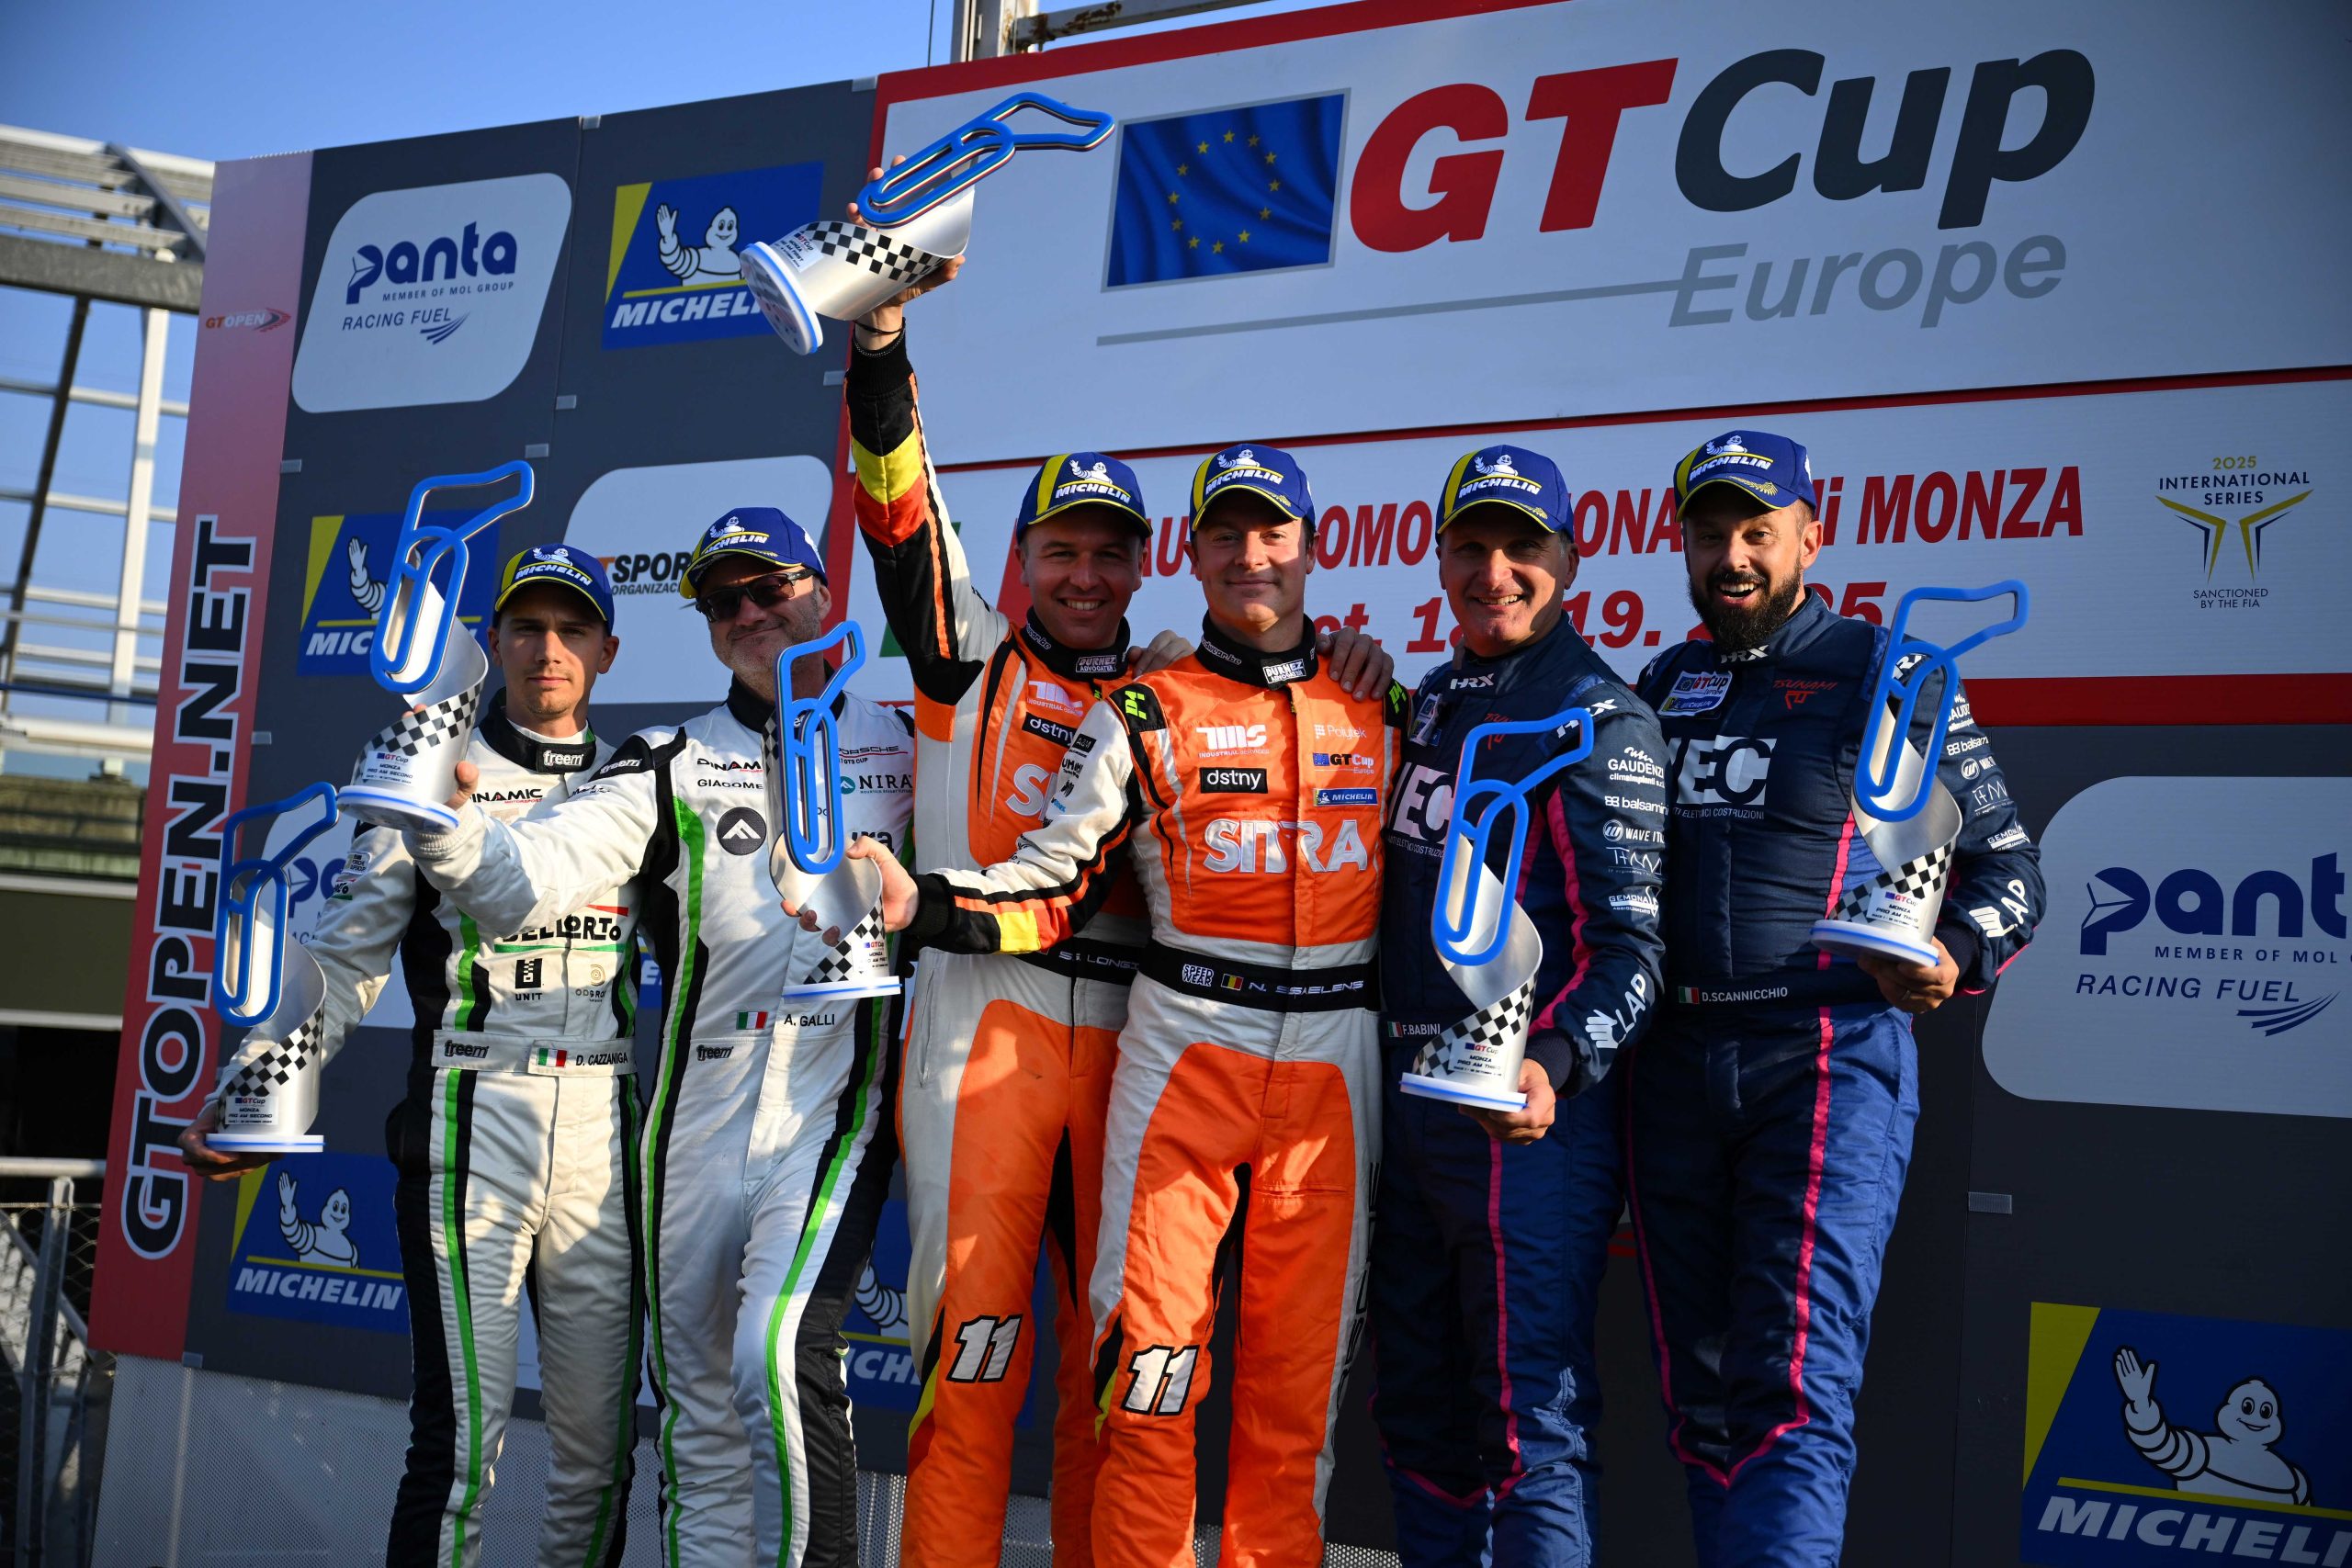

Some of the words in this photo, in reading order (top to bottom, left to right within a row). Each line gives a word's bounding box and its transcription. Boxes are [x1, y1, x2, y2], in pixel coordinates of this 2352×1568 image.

[346, 221, 517, 305] panta
[1668, 233, 2067, 329] Europe
[382, 289, 427, 302] MEMBER
[432, 288, 445, 297] OF
[449, 286, 471, 295] MOL
[477, 281, 515, 292] GROUP
[343, 312, 404, 331] RACING
[411, 308, 452, 325] FUEL
[1690, 452, 1773, 482] MICHELIN
[2212, 455, 2257, 470] 2025
[1204, 468, 1284, 495] MICHELIN
[1458, 475, 1543, 498] MICHELIN
[2159, 471, 2311, 490] INTERNATIONAL
[1055, 479, 1131, 504] MICHELIN
[2204, 491, 2264, 505] SERIES
[1856, 465, 2084, 545] MONZA
[515, 562, 593, 588] MICHELIN
[2193, 588, 2268, 599] SANCTIONED
[2200, 599, 2214, 609] BY
[2218, 598, 2238, 608] THE
[2243, 598, 2261, 608] FIA
[1721, 644, 1770, 664] HRX
[1450, 672, 1495, 690] HRX
[1773, 679, 1838, 691] TSUNAMI
[1327, 724, 1368, 739] Polytek
[543, 750, 584, 767] freem
[1198, 750, 1238, 759] INDUSTRIAL
[696, 758, 763, 772] DINAM
[1353, 767, 1374, 775] Europe
[1607, 758, 1666, 780] GAUDENZI
[696, 778, 764, 791] GIACOME
[858, 773, 913, 790] NIRA
[1206, 769, 1261, 790] dstny
[471, 788, 544, 804] INAMIC
[1331, 792, 1374, 801] MICHELIN
[1713, 807, 1765, 820] COSTRUZIONI
[1625, 827, 1651, 842] WAVE
[1609, 893, 1650, 904] GEMONA
[2080, 852, 2348, 956] pant
[1888, 904, 1911, 914] MONZA
[1087, 953, 1140, 970] LONGI
[2154, 946, 2244, 961] MEMBER
[2255, 949, 2281, 962] OF
[2293, 950, 2338, 964] MOL
[1183, 964, 1214, 978] SPEED
[1182, 974, 1213, 987] WEAR
[1249, 982, 1267, 993] N.
[2075, 974, 2201, 998] RACING
[2216, 978, 2300, 1002] FUEL
[514, 992, 543, 1001] UNIT
[1702, 986, 1788, 1003] D.SCANNICCHIO
[783, 1015, 797, 1027] A.
[799, 1013, 835, 1027] GALLI
[1402, 1022, 1441, 1035] F.BABINI
[444, 1039, 490, 1059] freem
[696, 1043, 734, 1062] freem
[576, 1055, 586, 1066] D.
[587, 1051, 628, 1066] CAZZANIGA
[1469, 1055, 1492, 1063] MONZA
[234, 1268, 403, 1311] MICHELIN
[945, 1314, 1023, 1383] 11
[1120, 1344, 1200, 1416] 11
[2038, 1495, 2352, 1568] MICHELI
